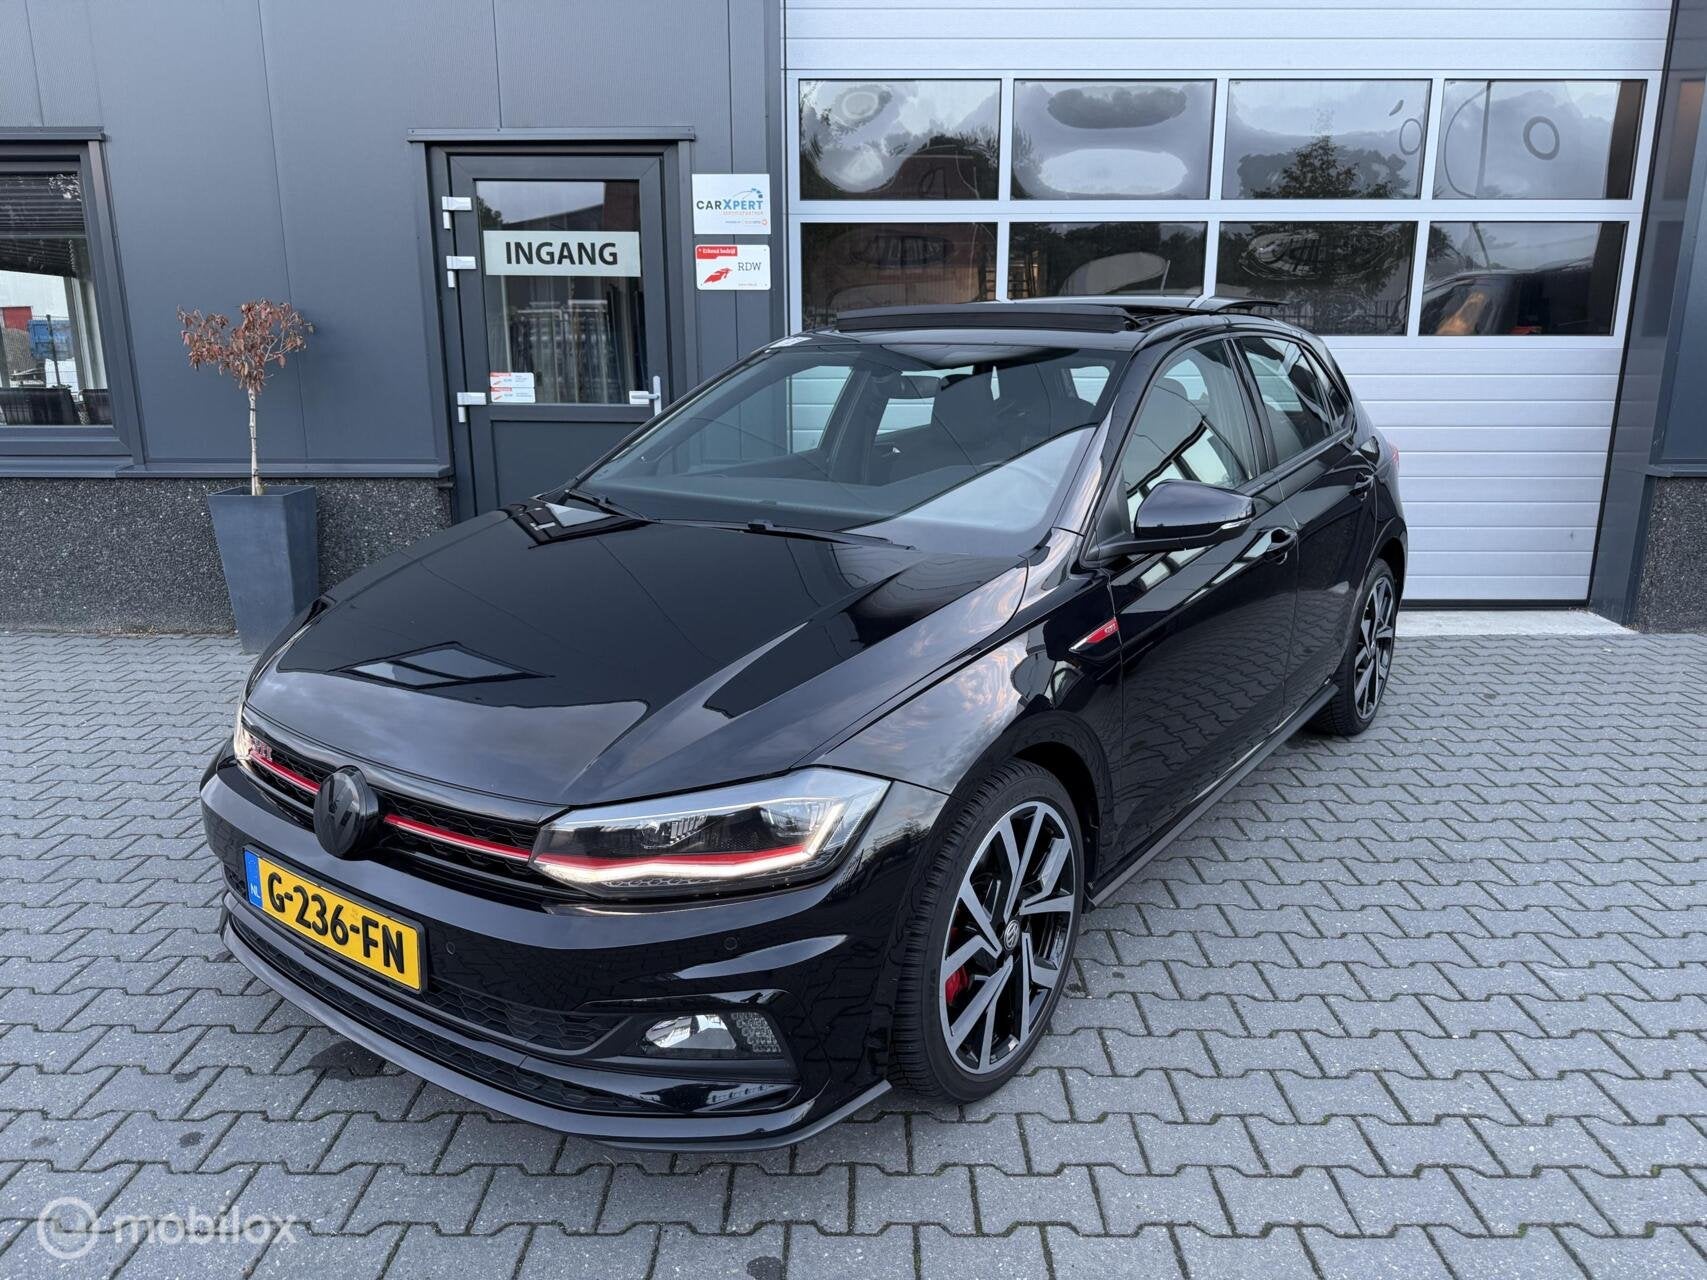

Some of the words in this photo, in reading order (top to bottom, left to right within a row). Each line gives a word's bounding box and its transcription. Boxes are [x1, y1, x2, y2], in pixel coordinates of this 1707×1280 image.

[696, 199, 763, 210] CARXPERT
[505, 241, 618, 266] INGANG
[738, 262, 762, 271] RDW
[250, 882, 261, 899] NL
[267, 872, 405, 974] G-236-FN
